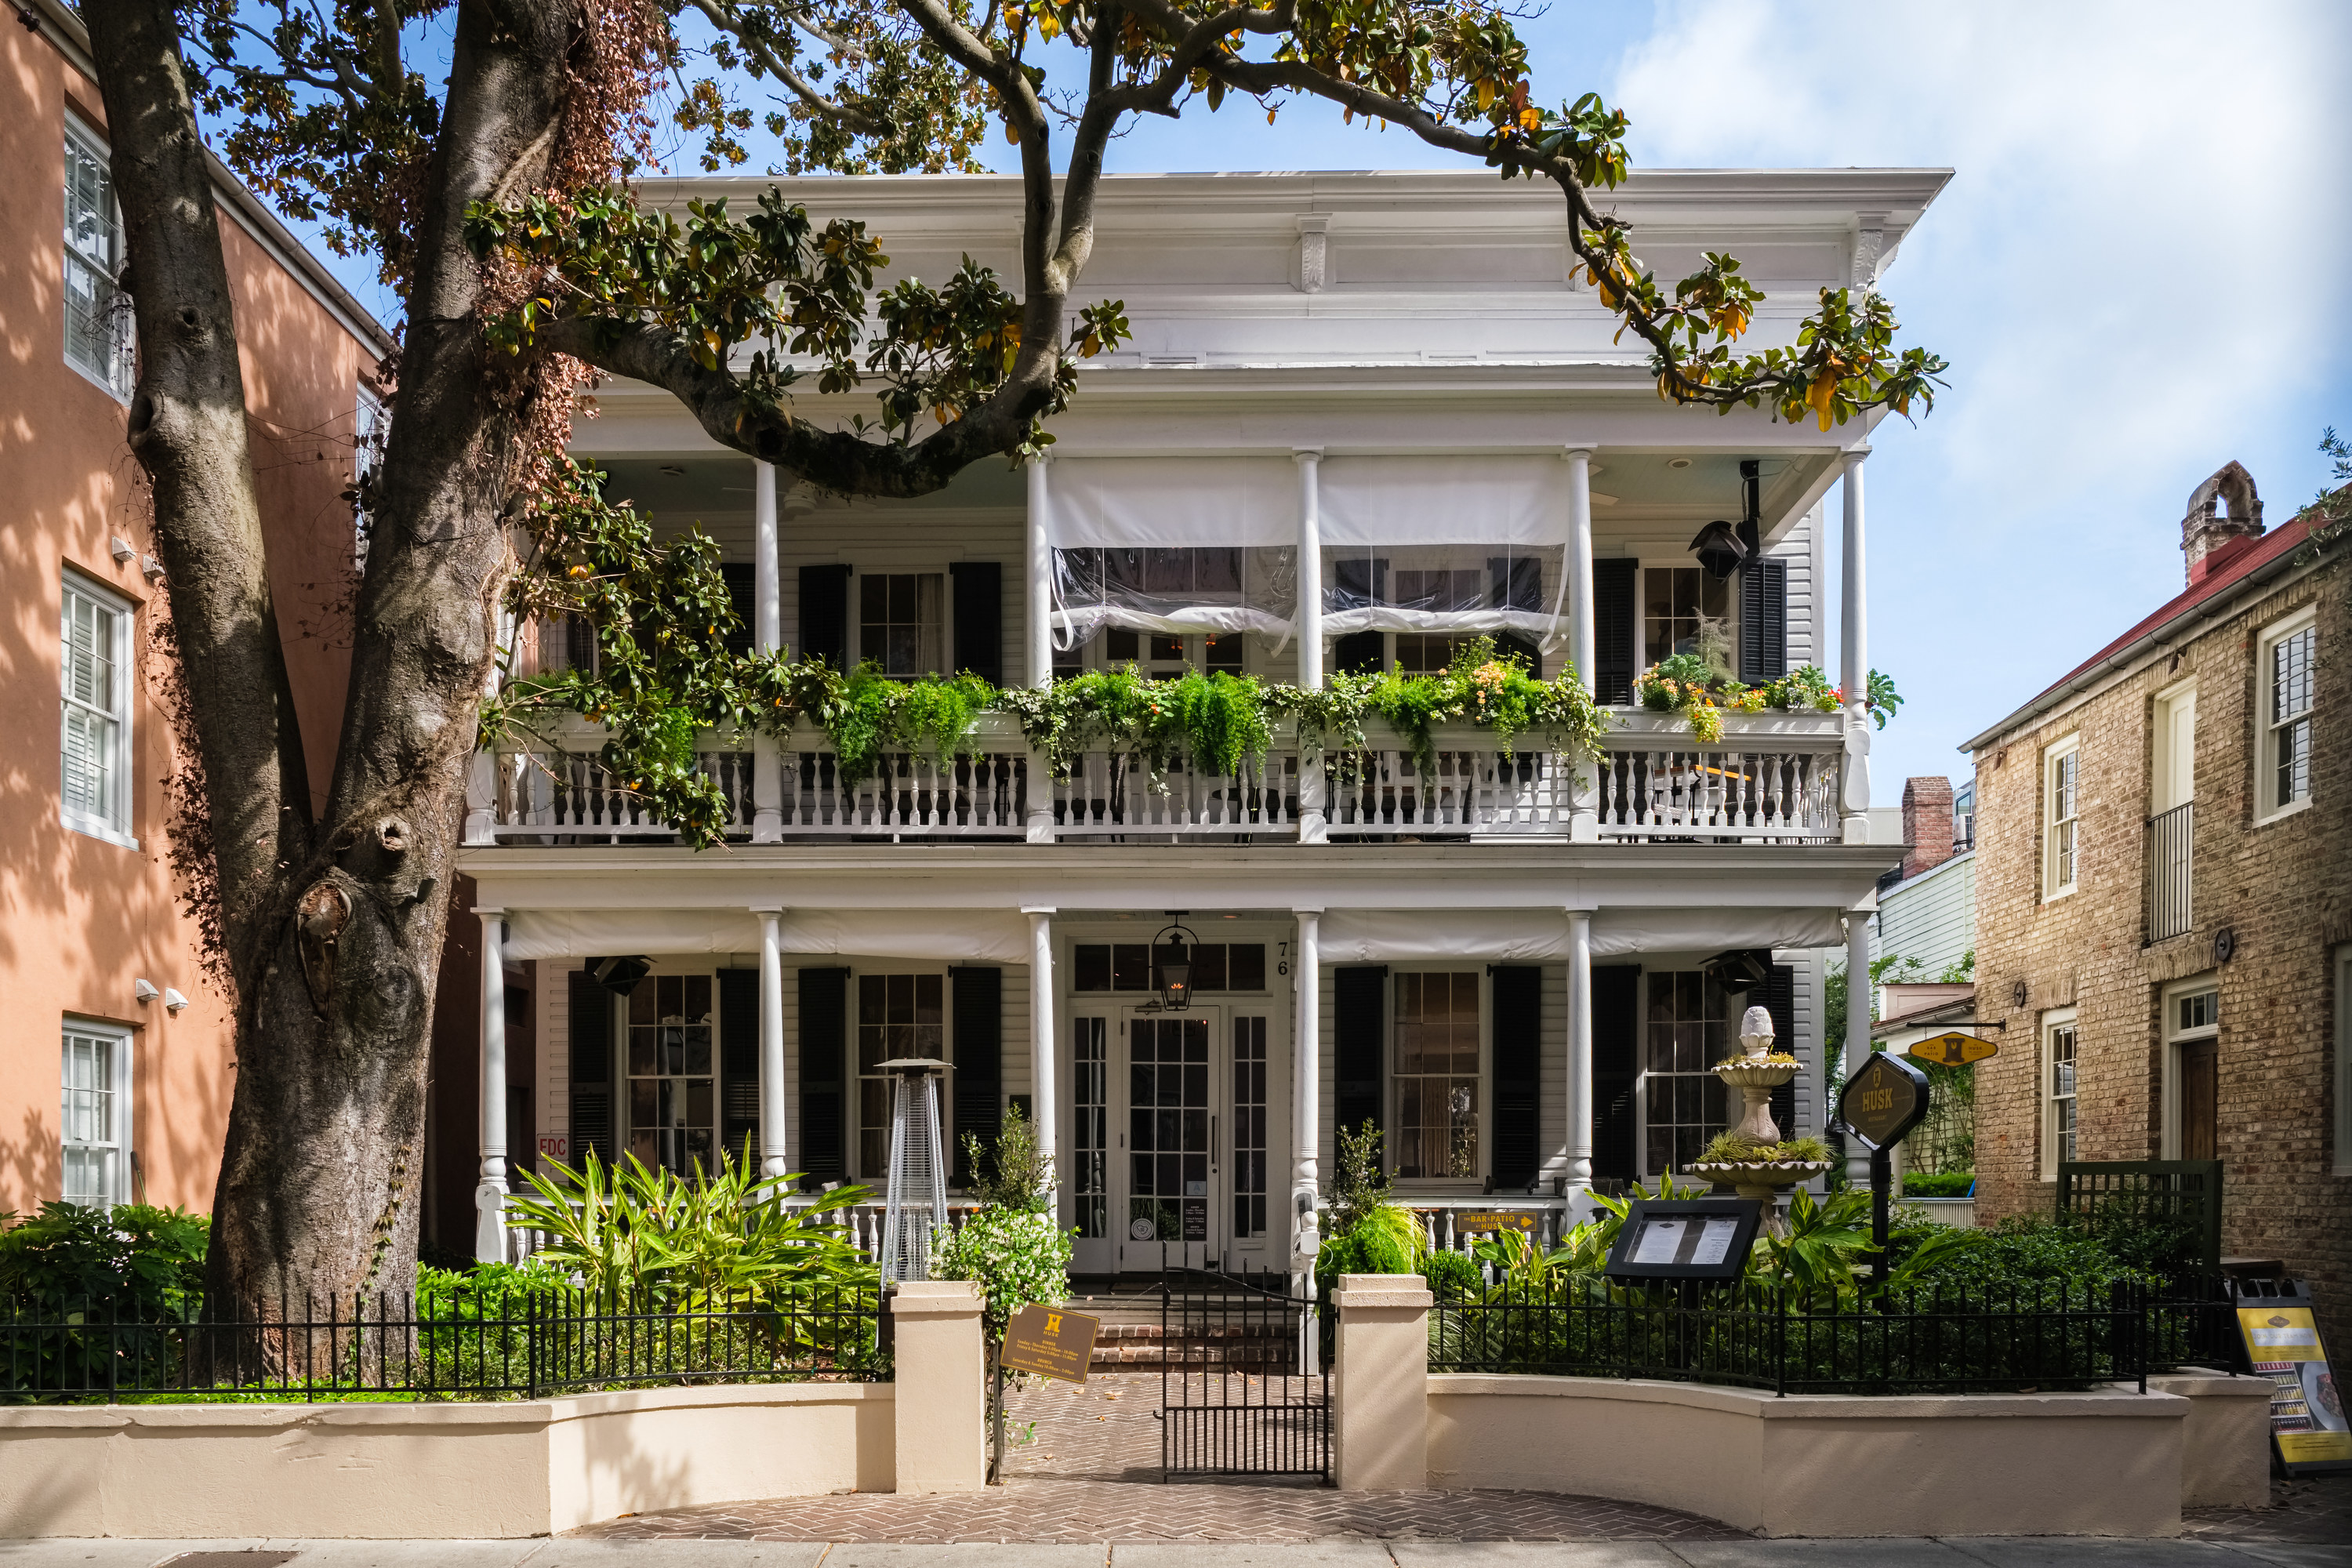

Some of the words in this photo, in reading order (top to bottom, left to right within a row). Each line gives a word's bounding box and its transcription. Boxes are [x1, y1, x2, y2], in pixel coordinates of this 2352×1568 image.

[1278, 942, 1288, 975] 76
[1862, 1087, 1893, 1112] HUSK
[539, 1138, 566, 1156] FDC
